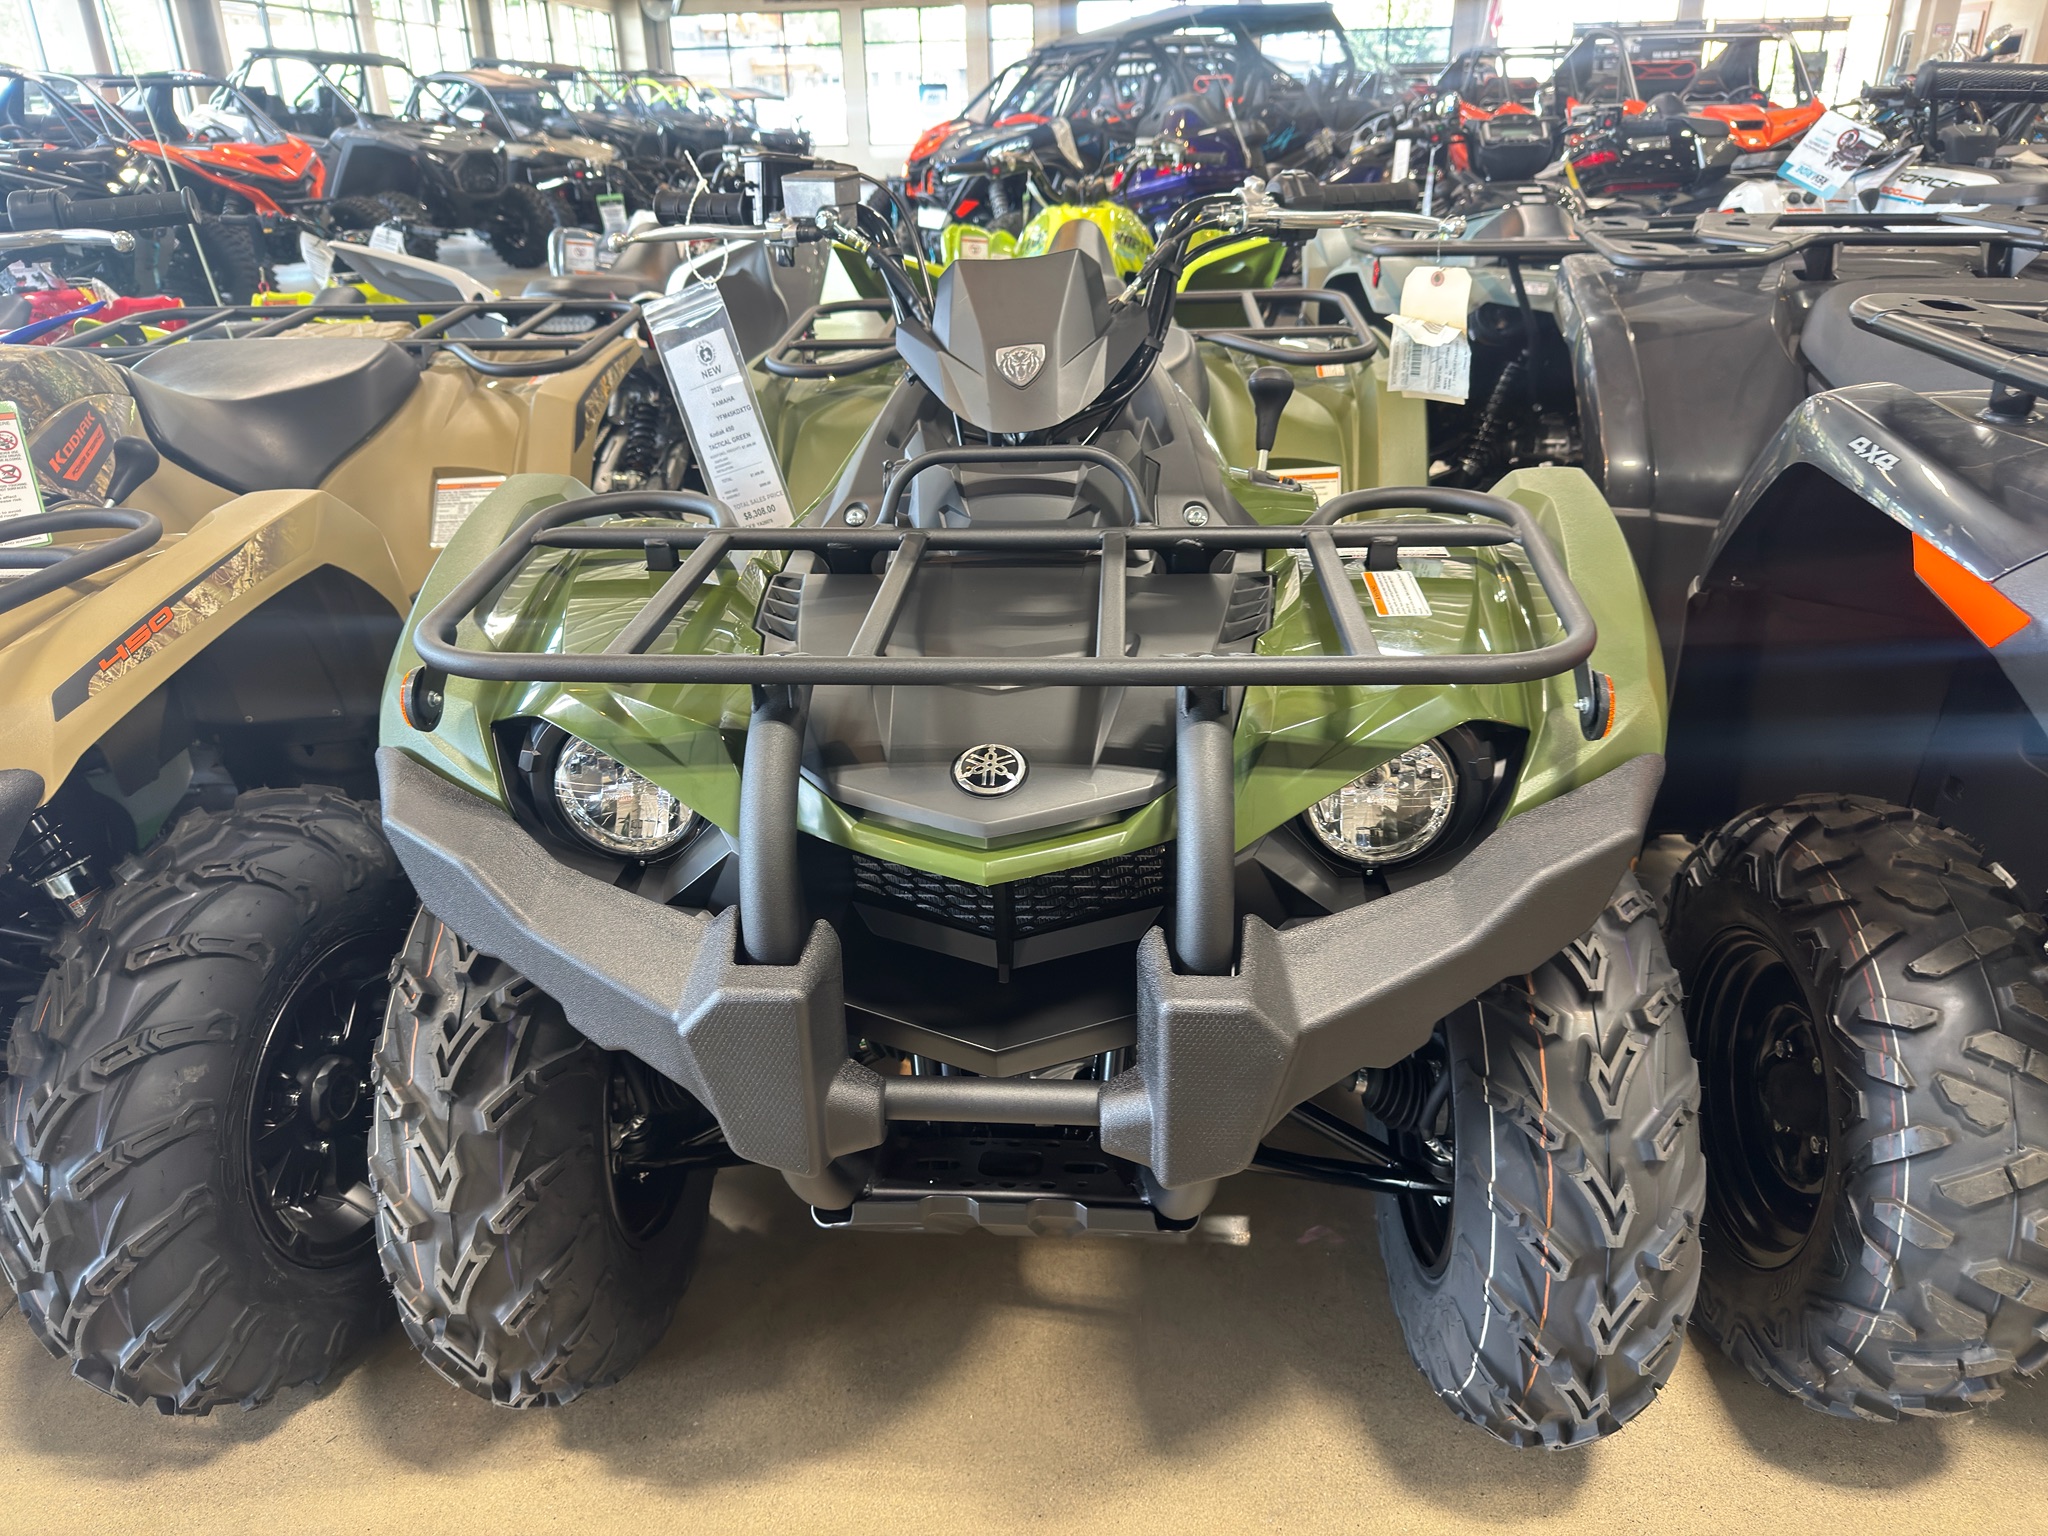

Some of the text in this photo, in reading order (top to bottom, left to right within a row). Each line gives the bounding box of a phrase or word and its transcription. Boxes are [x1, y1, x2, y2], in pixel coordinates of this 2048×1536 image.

[701, 364, 722, 380] NEW
[712, 396, 735, 408] YAMAHA
[48, 410, 96, 474] KODIAK
[708, 432, 752, 450] TACTICAL GREEN
[709, 429, 726, 438] Kodiak
[1848, 436, 1900, 471] 4X4
[733, 490, 784, 510] TOTAL SALES PRICE
[743, 504, 776, 520] $8,308.00
[98, 606, 174, 672] 450
